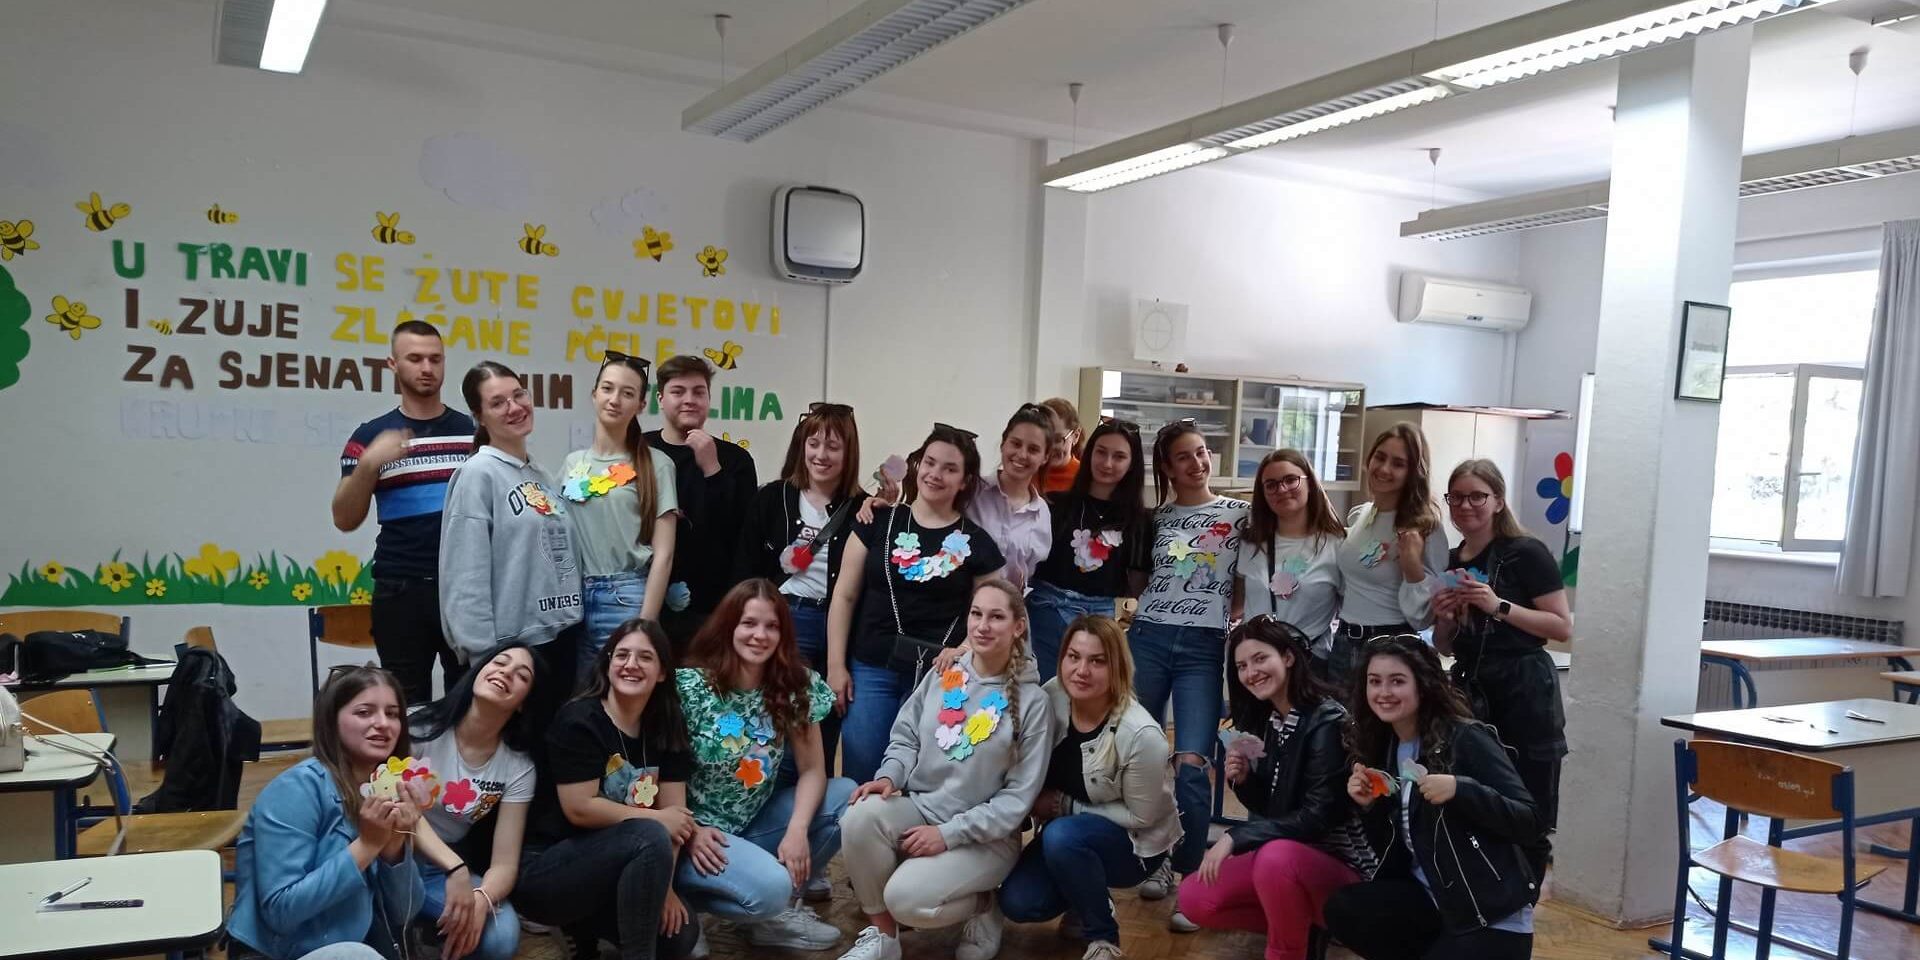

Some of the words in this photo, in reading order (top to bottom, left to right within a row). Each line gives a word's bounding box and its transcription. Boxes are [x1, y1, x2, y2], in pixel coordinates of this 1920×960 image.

[113, 240, 145, 279] U
[178, 243, 308, 286] TRAVI
[335, 252, 385, 292] SE
[571, 284, 782, 336] CVJETOVI
[125, 288, 139, 329] I
[176, 297, 300, 339] ZUJE
[123, 344, 195, 390] ZA
[218, 350, 403, 395] SJENAT
